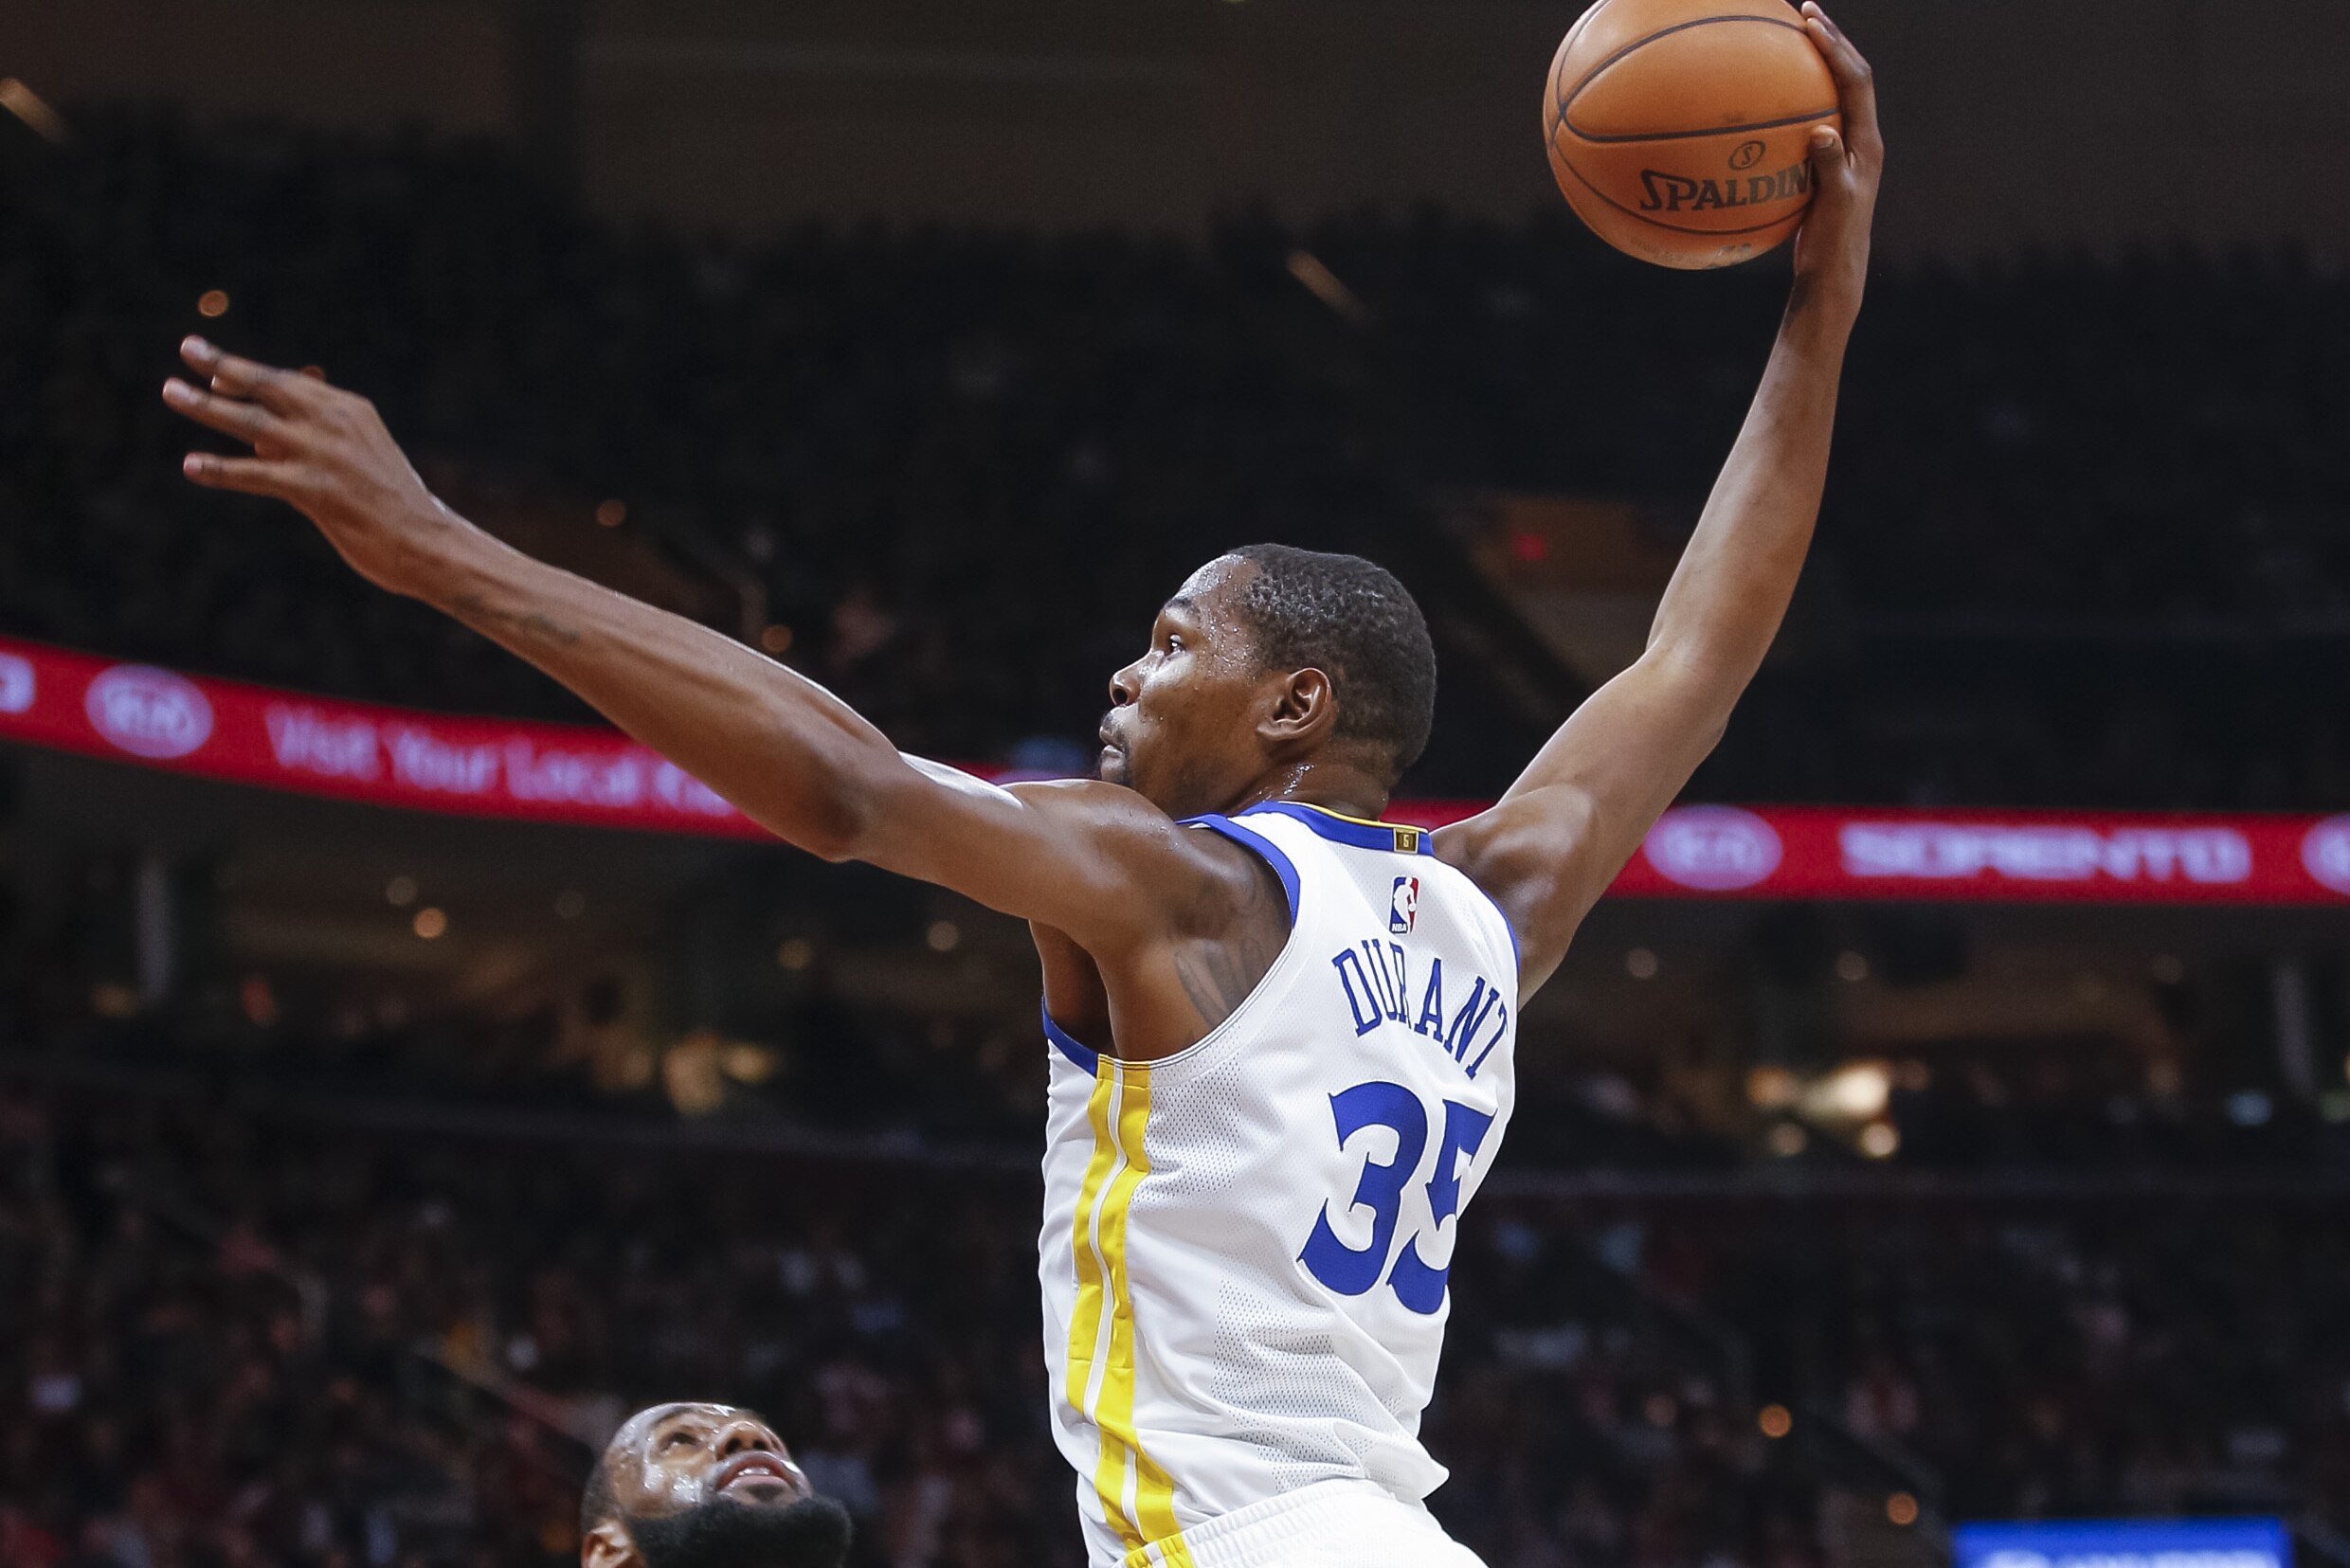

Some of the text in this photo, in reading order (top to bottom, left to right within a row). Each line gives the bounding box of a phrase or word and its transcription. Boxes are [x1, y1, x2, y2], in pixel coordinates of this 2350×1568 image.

[1639, 159, 1811, 210] SPALDIN
[264, 702, 381, 782] Visit
[382, 721, 502, 794] Your
[504, 734, 641, 807] Local
[1391, 923, 1408, 932] NBA
[1296, 1081, 1497, 1314] 35
